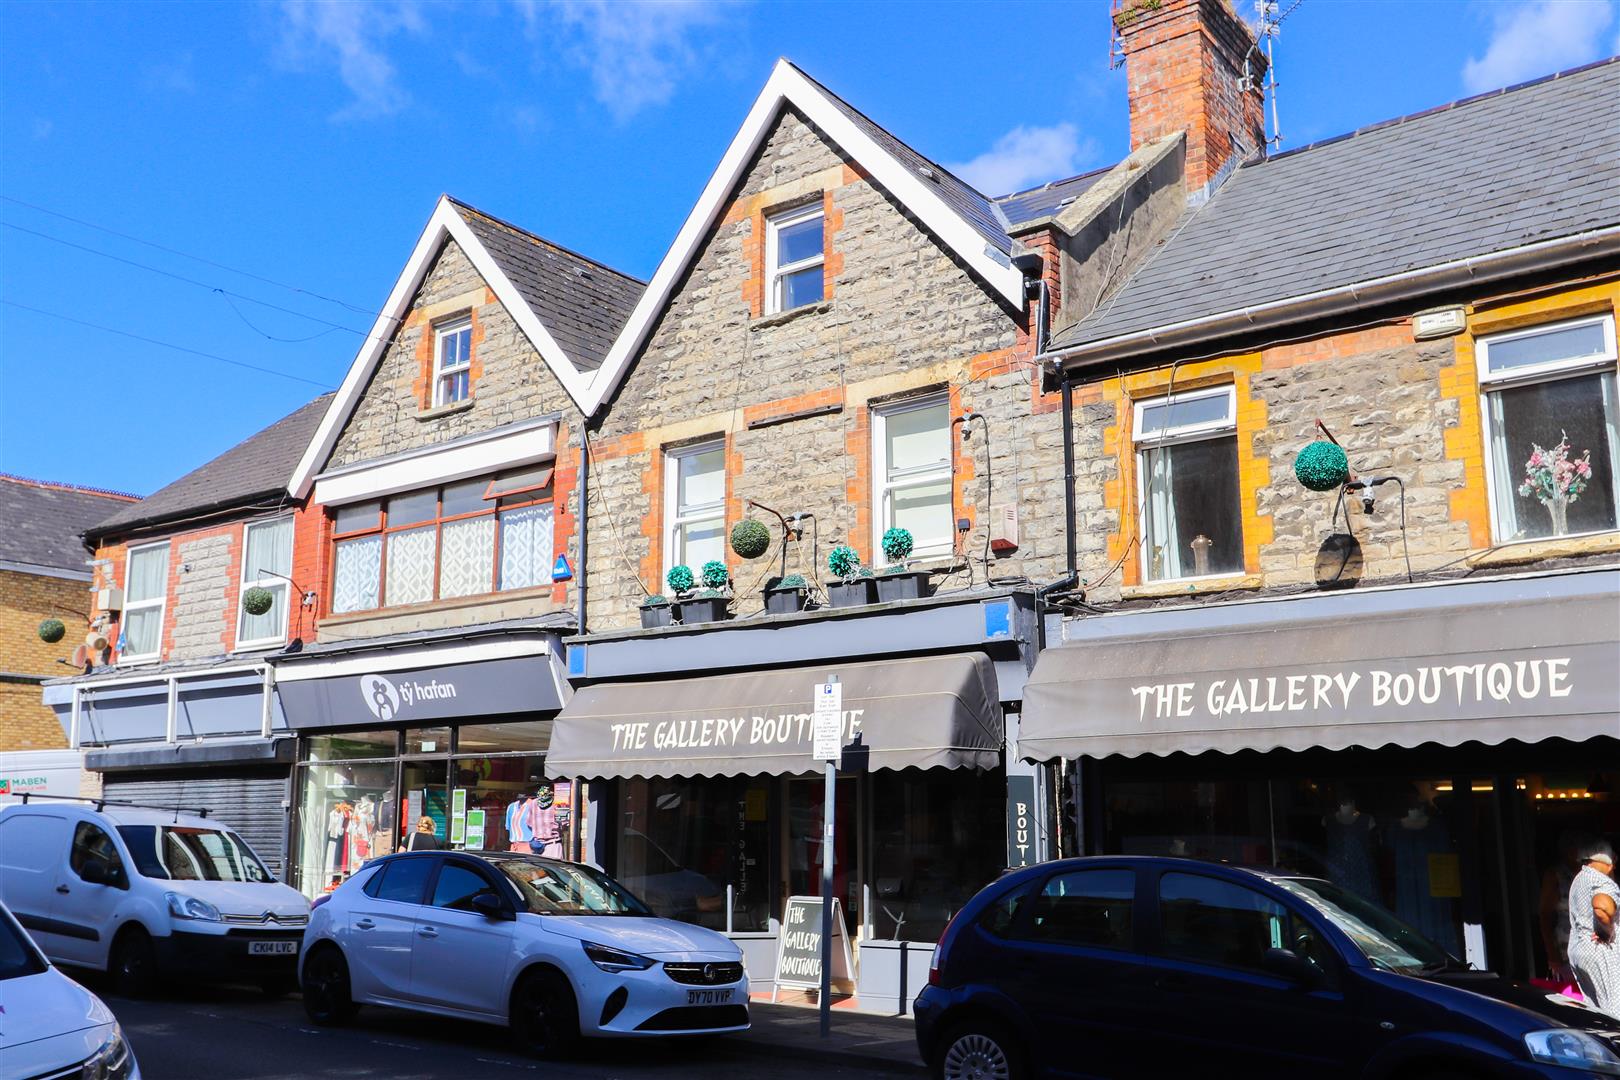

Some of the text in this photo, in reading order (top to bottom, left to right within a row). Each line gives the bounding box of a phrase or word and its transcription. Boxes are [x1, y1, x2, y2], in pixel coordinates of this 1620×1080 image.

[413, 679, 457, 700] hafan
[1130, 657, 1575, 723] THE GALLERY BOUTIQUE
[610, 722, 650, 753] THE
[653, 717, 746, 752] GALLERY
[749, 709, 865, 745] BOUTIE
[12, 776, 48, 786] MABEN
[789, 906, 806, 924] THE
[253, 942, 273, 953] CK14
[785, 931, 821, 952] GALLERY
[688, 991, 713, 1004] DY70
